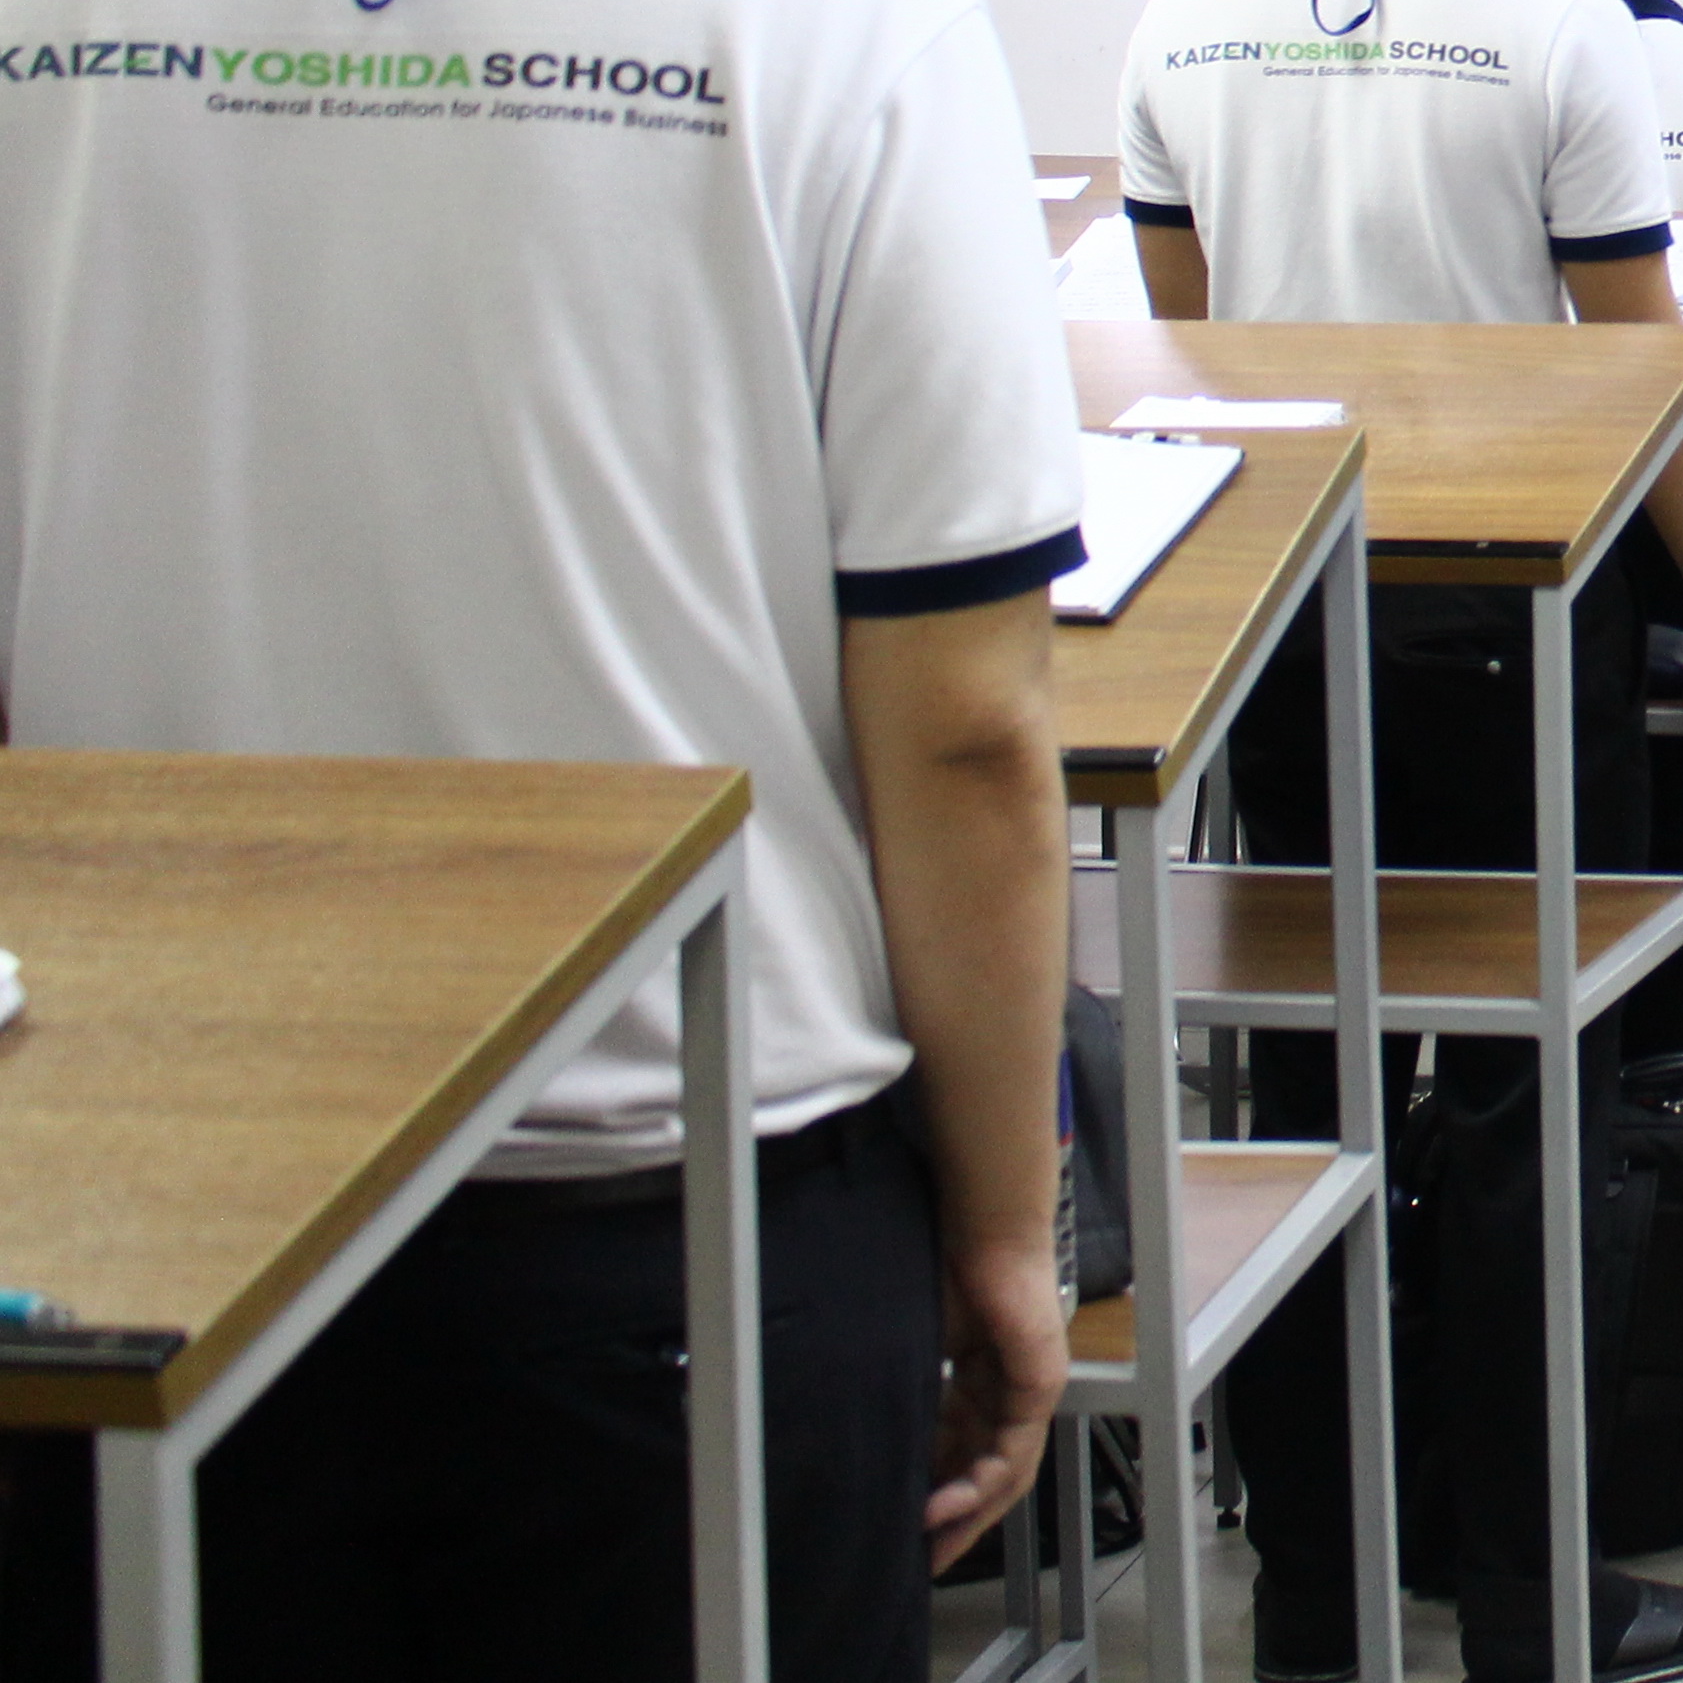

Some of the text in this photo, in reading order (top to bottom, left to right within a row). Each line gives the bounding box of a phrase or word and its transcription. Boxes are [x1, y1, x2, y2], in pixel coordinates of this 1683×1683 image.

[1263, 66, 1314, 77] General
[1317, 66, 1373, 76] Education
[1392, 66, 1451, 79] Japanese
[1455, 70, 1510, 86] Business
[206, 92, 728, 138] General Education for Japanese Business
